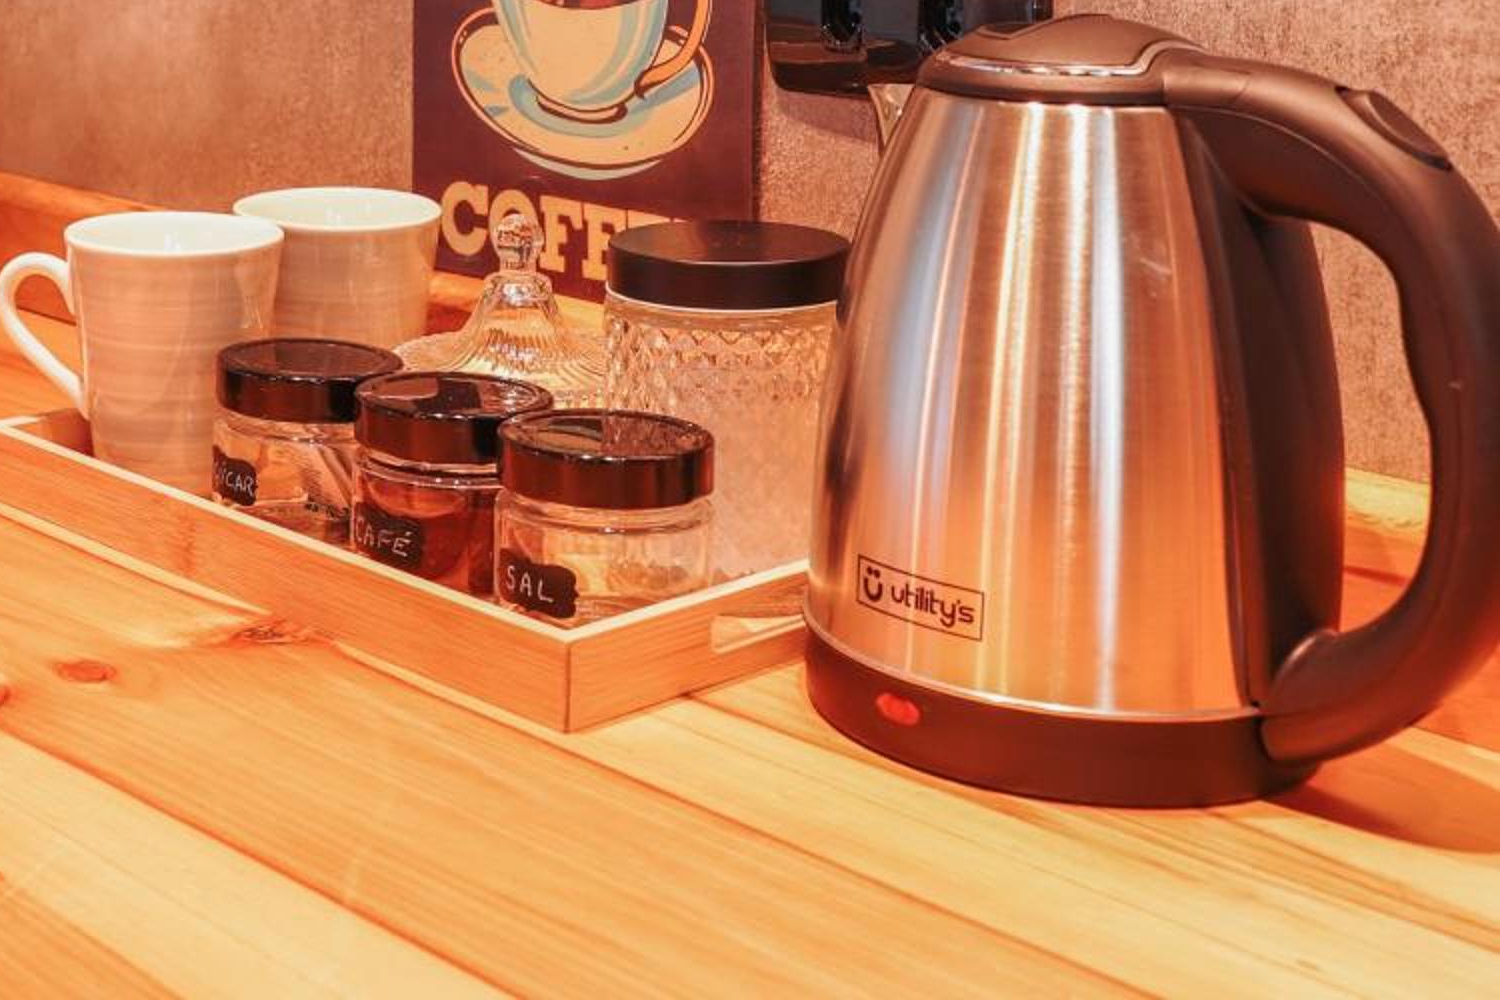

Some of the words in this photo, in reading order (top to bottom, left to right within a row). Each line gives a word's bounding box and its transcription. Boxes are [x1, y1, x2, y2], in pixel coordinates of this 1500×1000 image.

[355, 516, 413, 557] CAFÉ
[505, 564, 555, 604] SAL
[891, 583, 975, 628] utility's
